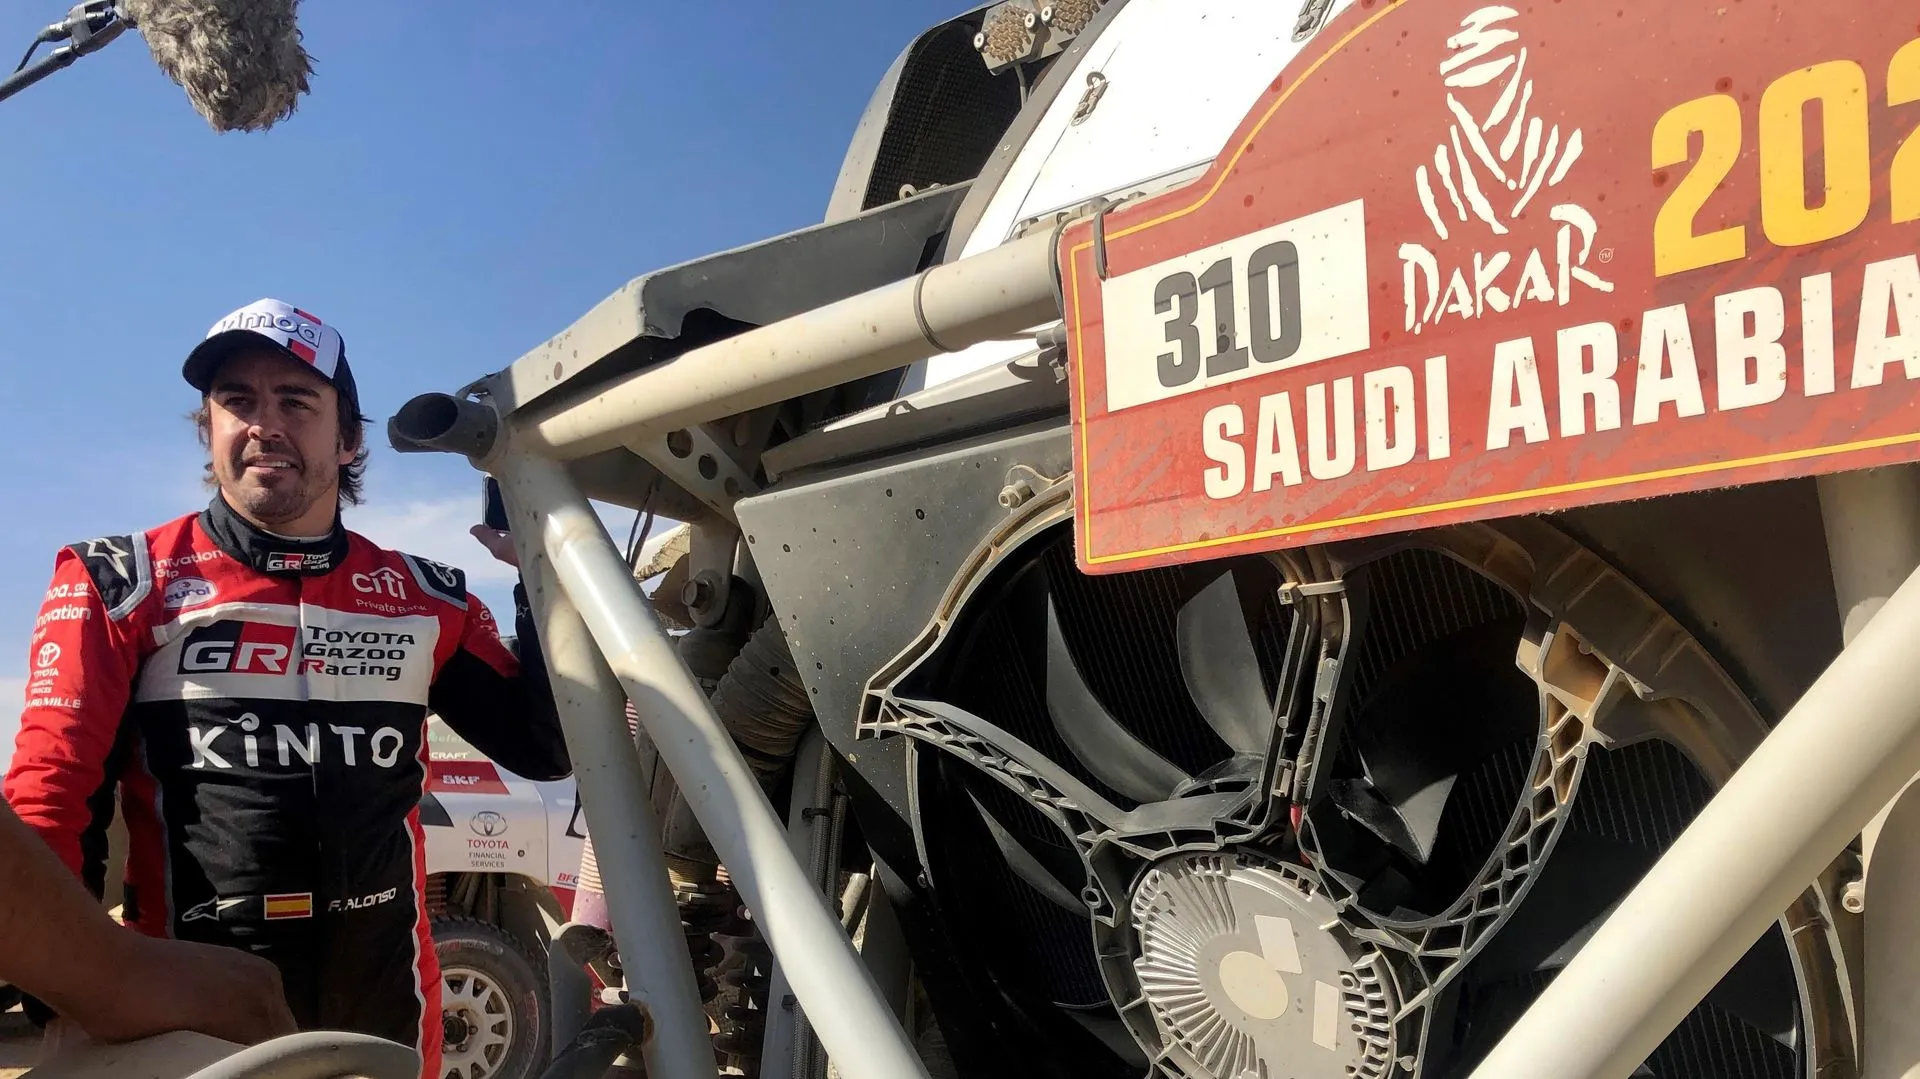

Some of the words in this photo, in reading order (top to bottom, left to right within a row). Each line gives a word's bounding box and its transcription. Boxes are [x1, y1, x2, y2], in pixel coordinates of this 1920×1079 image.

[1399, 204, 1615, 335] DAKAR
[1153, 240, 1302, 388] 310
[1202, 356, 1452, 500] SAUDI
[1486, 254, 1920, 452] ARABIA
[352, 567, 407, 600] citi
[165, 586, 210, 603] eurol
[356, 599, 396, 614] Private
[306, 626, 415, 645] TOYOTA
[183, 641, 288, 672] GR
[304, 643, 406, 660] GAZOO
[297, 659, 401, 681] Racing
[443, 775, 480, 785] SKF
[467, 839, 509, 849] TOYOTA
[469, 852, 506, 860] FINANCIAL
[471, 860, 505, 868] SERVICES
[328, 900, 342, 912] F.
[345, 888, 397, 910] ALONSO
